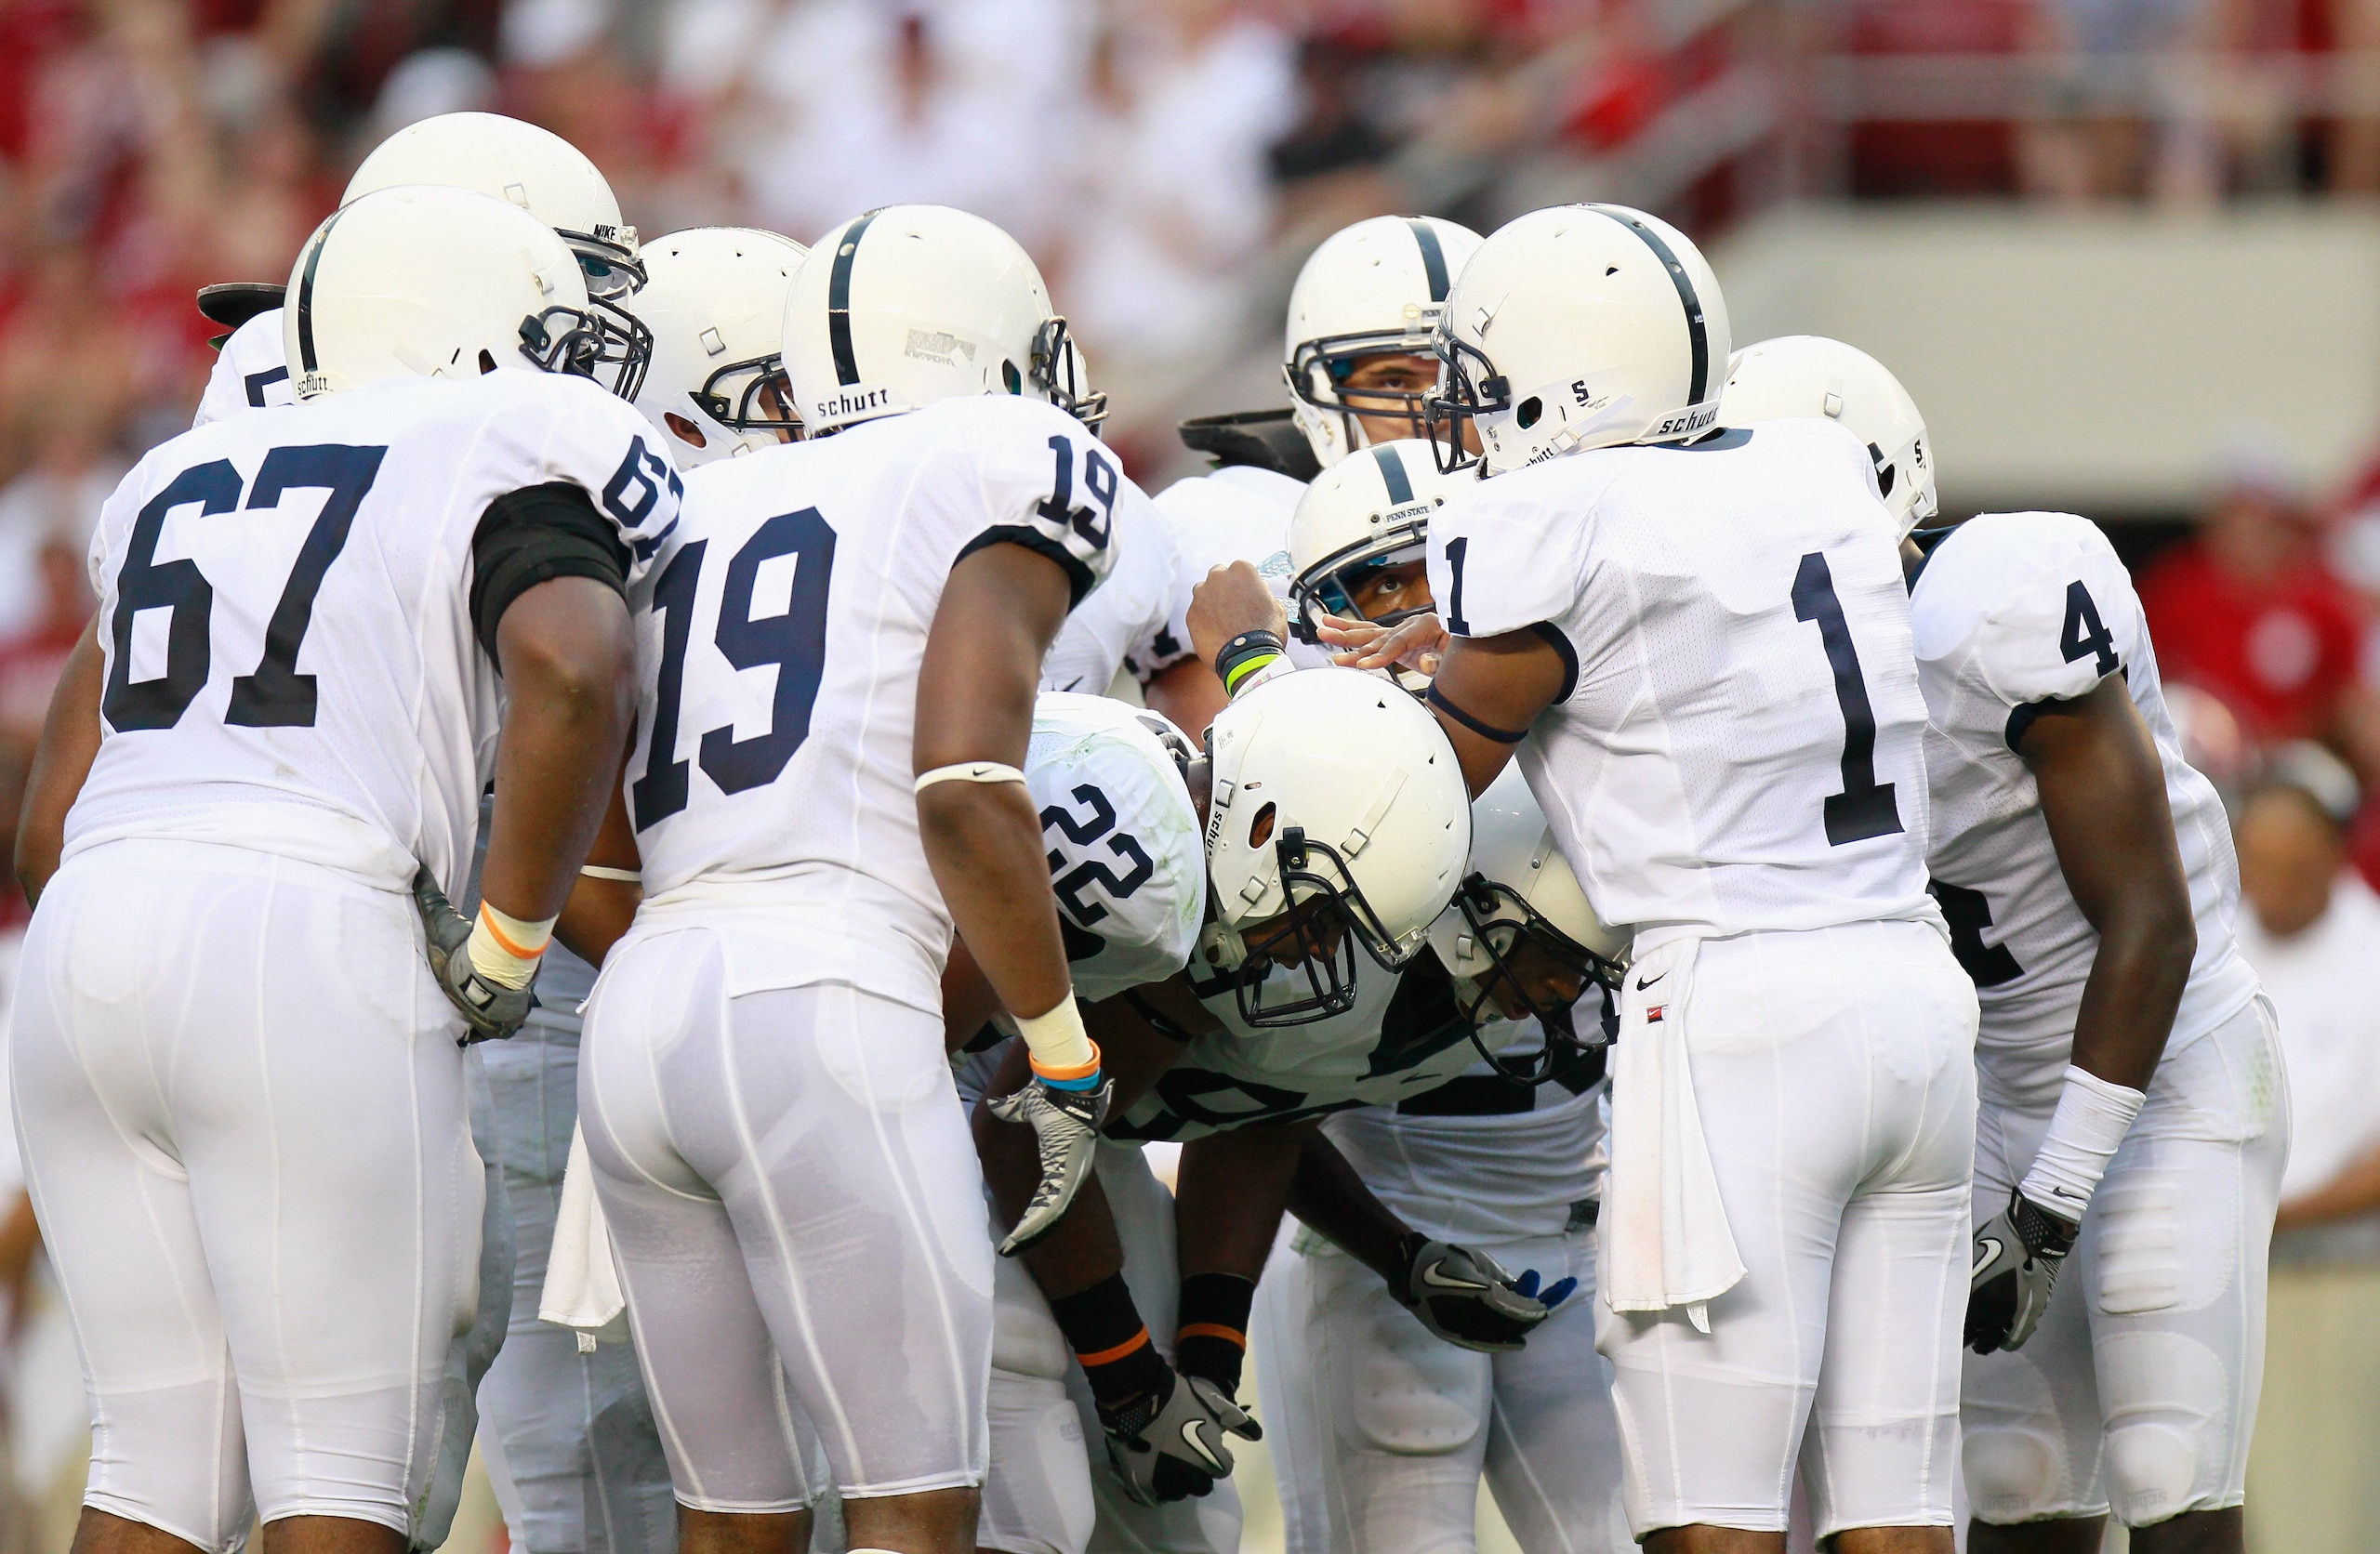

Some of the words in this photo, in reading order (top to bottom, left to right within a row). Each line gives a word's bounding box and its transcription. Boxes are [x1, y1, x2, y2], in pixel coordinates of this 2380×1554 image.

[594, 224, 616, 241] NIKE
[298, 375, 328, 396] schutt
[818, 388, 888, 417] schutt
[1571, 380, 1590, 403] S
[1037, 435, 1117, 551] 19
[1386, 510, 1407, 522] PENN
[1408, 506, 1430, 517] STATE
[102, 443, 390, 733] 67
[1446, 536, 1471, 637] 1
[2059, 580, 2120, 678] 4
[632, 506, 838, 835] 19
[1792, 552, 1906, 847] 1
[1039, 784, 1154, 928] 22
